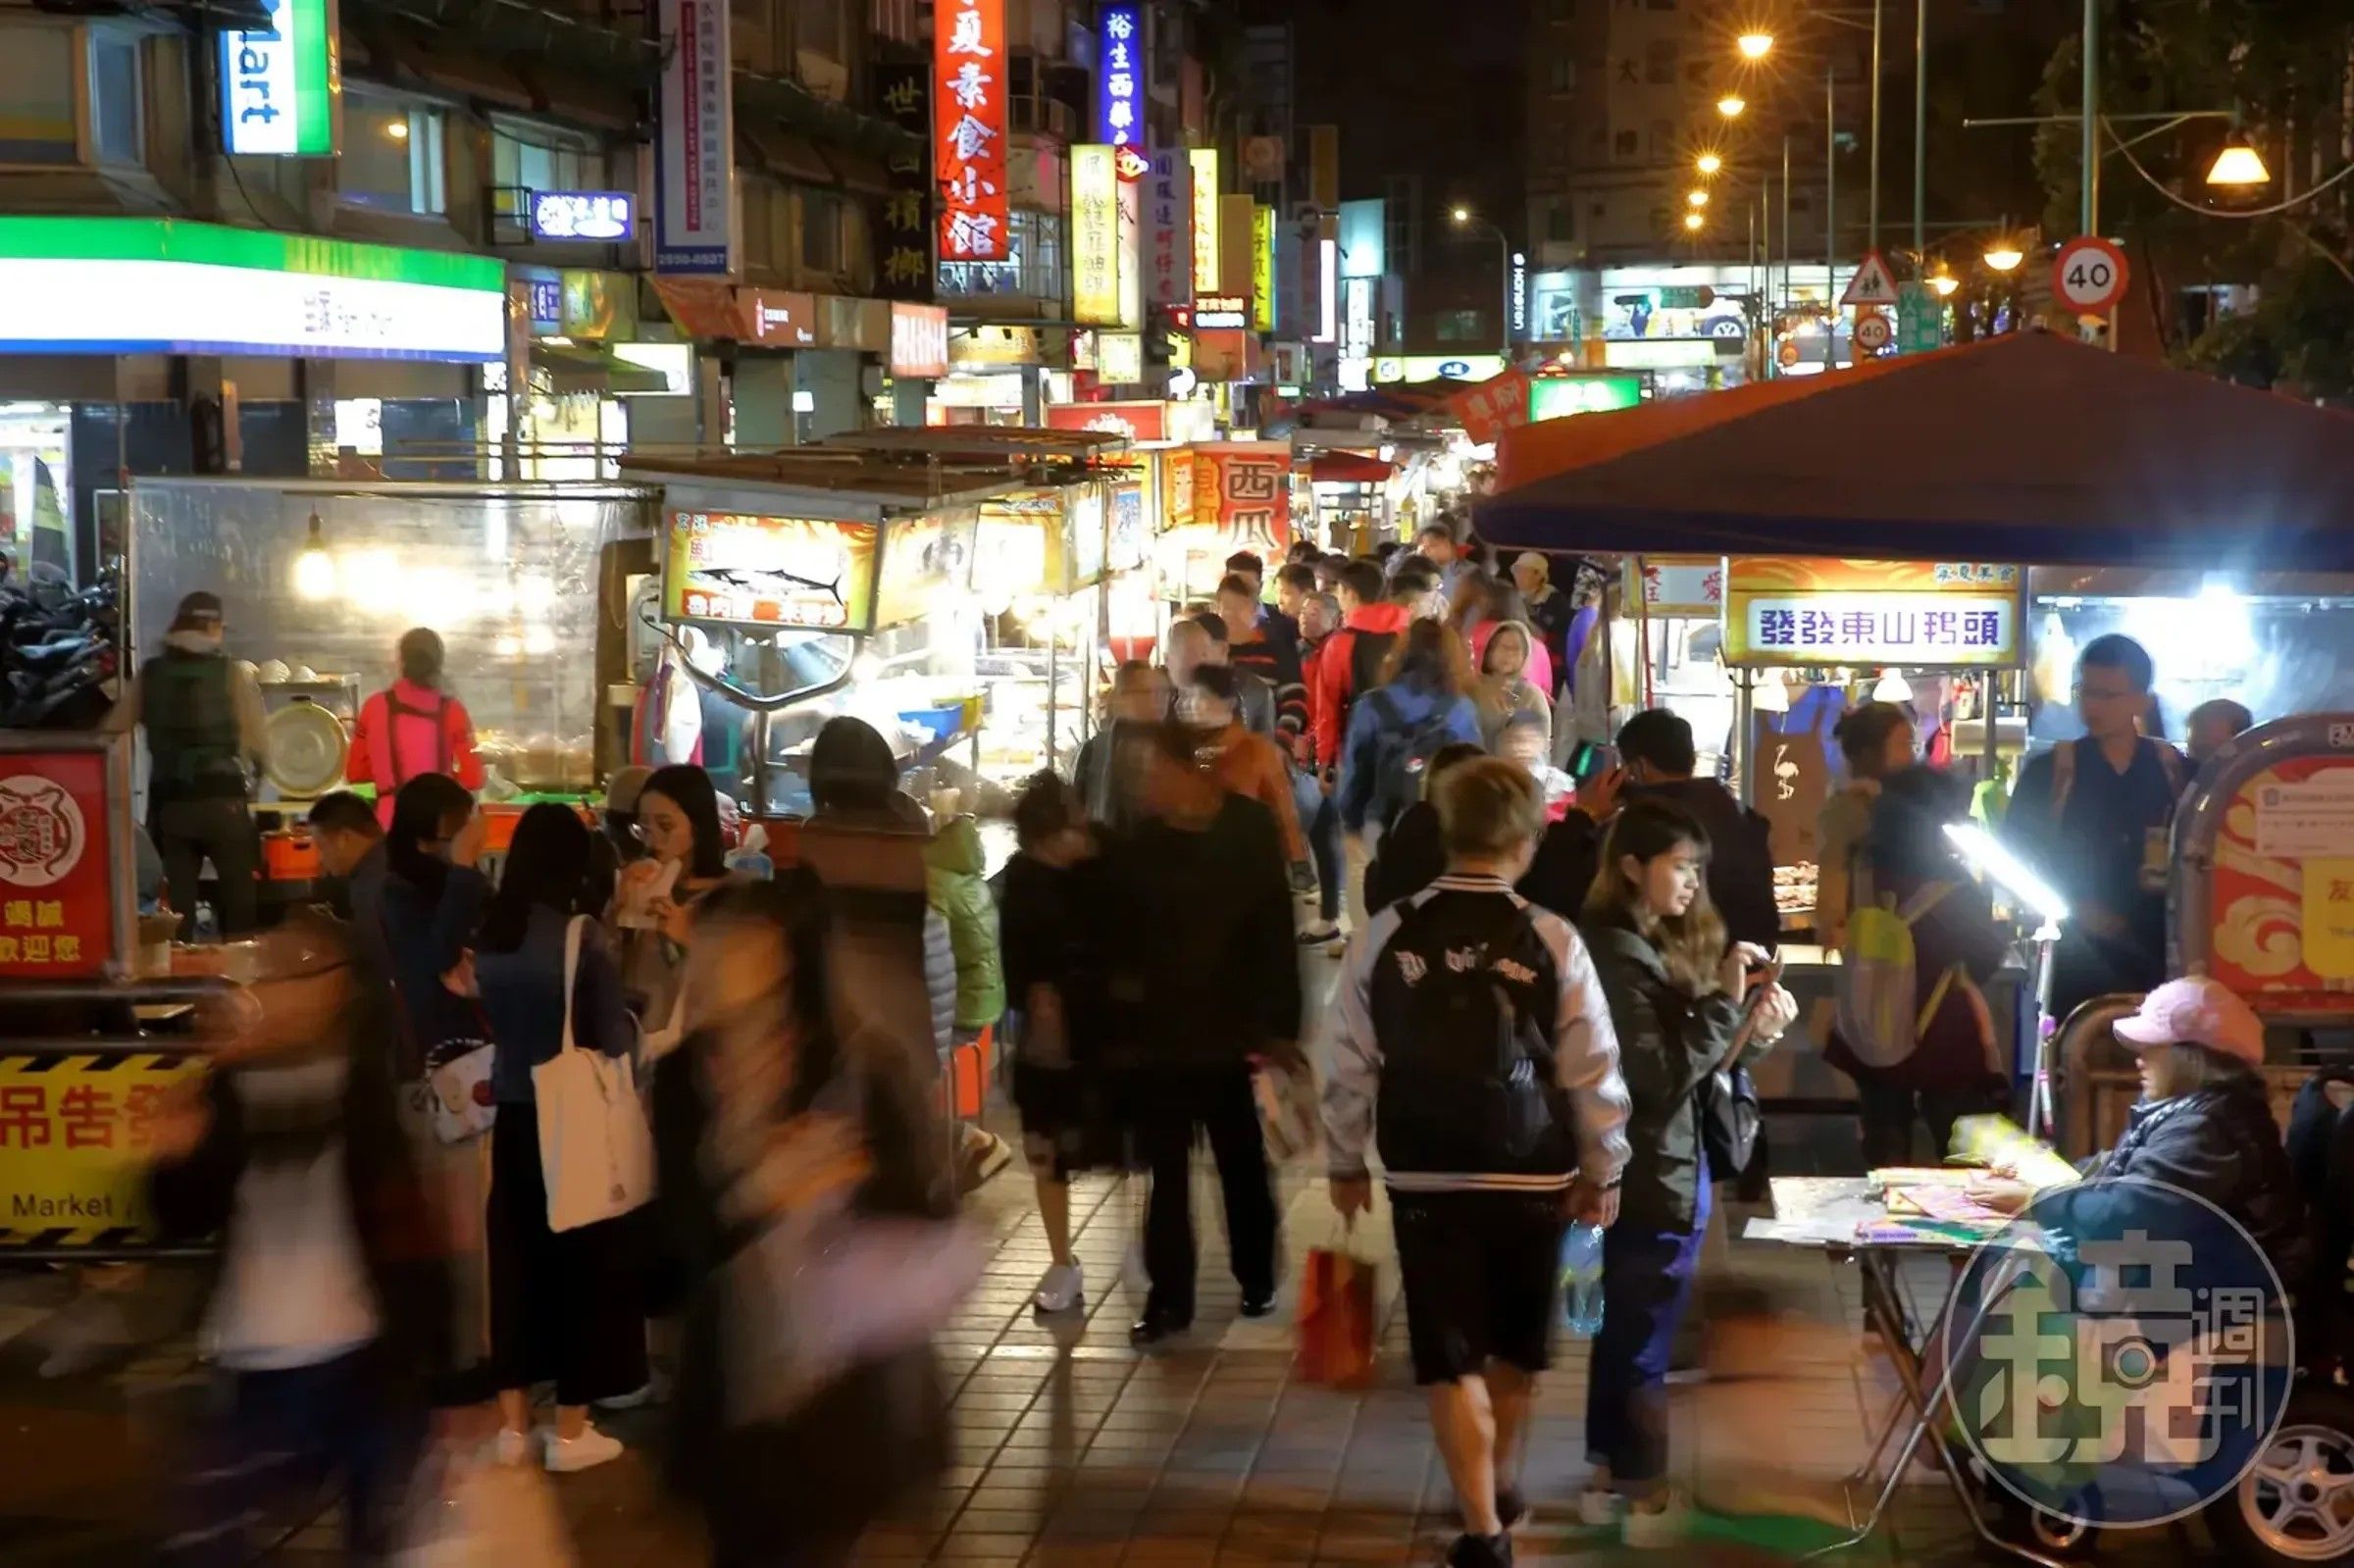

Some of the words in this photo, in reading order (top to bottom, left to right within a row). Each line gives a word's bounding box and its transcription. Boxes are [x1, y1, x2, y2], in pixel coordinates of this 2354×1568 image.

[947, 0, 998, 255] 夏素食小館
[2067, 264, 2111, 288] 40
[1862, 326, 1884, 337] 40
[1227, 460, 1278, 549] 西瓜
[1761, 609, 2000, 646] 發發東山鴨頭
[12, 1193, 113, 1218] Market
